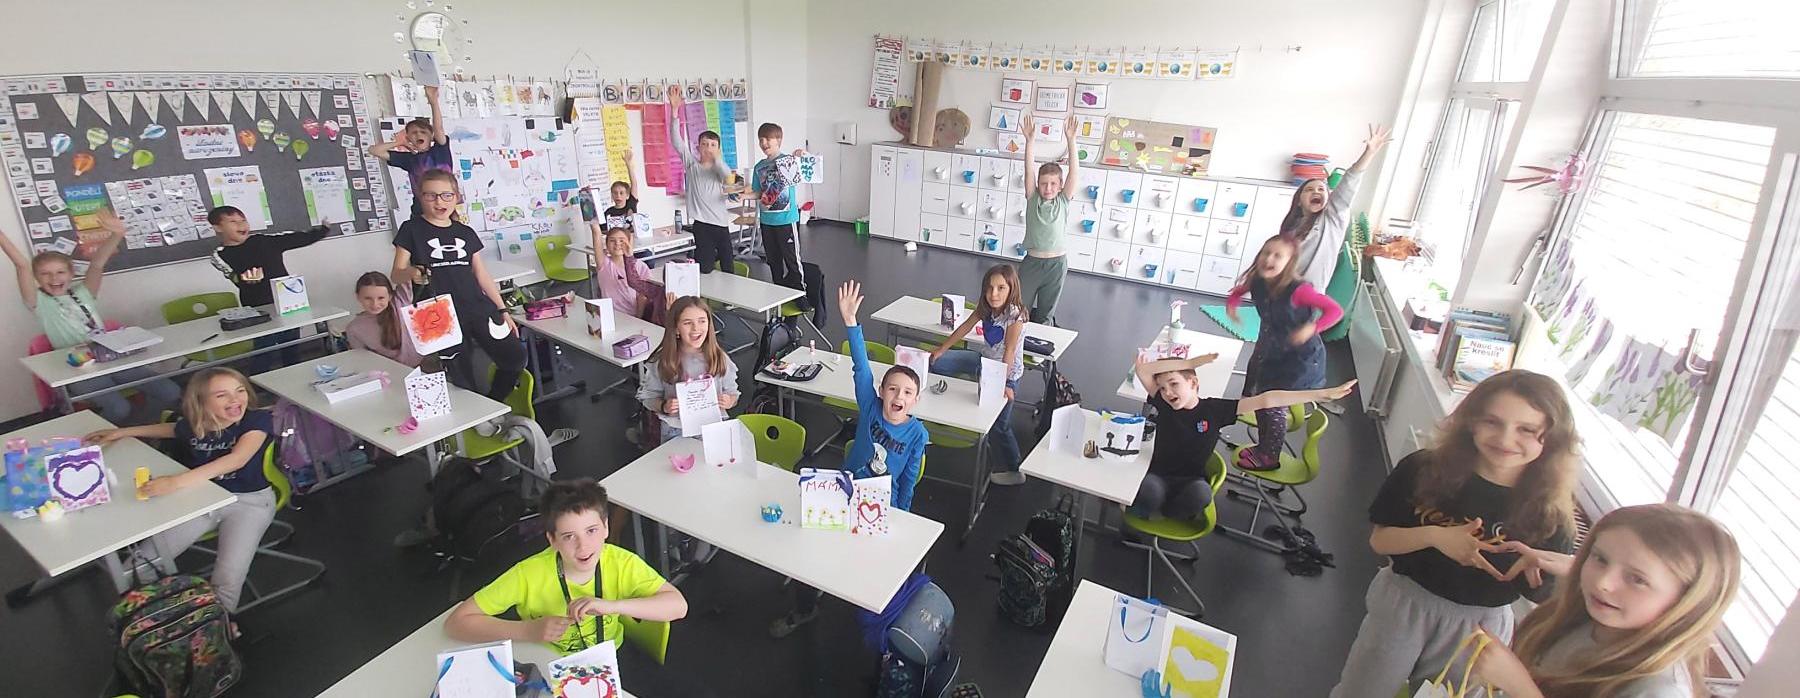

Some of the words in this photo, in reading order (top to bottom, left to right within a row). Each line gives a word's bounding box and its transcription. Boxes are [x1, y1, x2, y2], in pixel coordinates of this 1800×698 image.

[1470, 340, 1492, 351] Nauč
[1472, 348, 1500, 358] kreslit
[806, 480, 842, 492] MÁM
